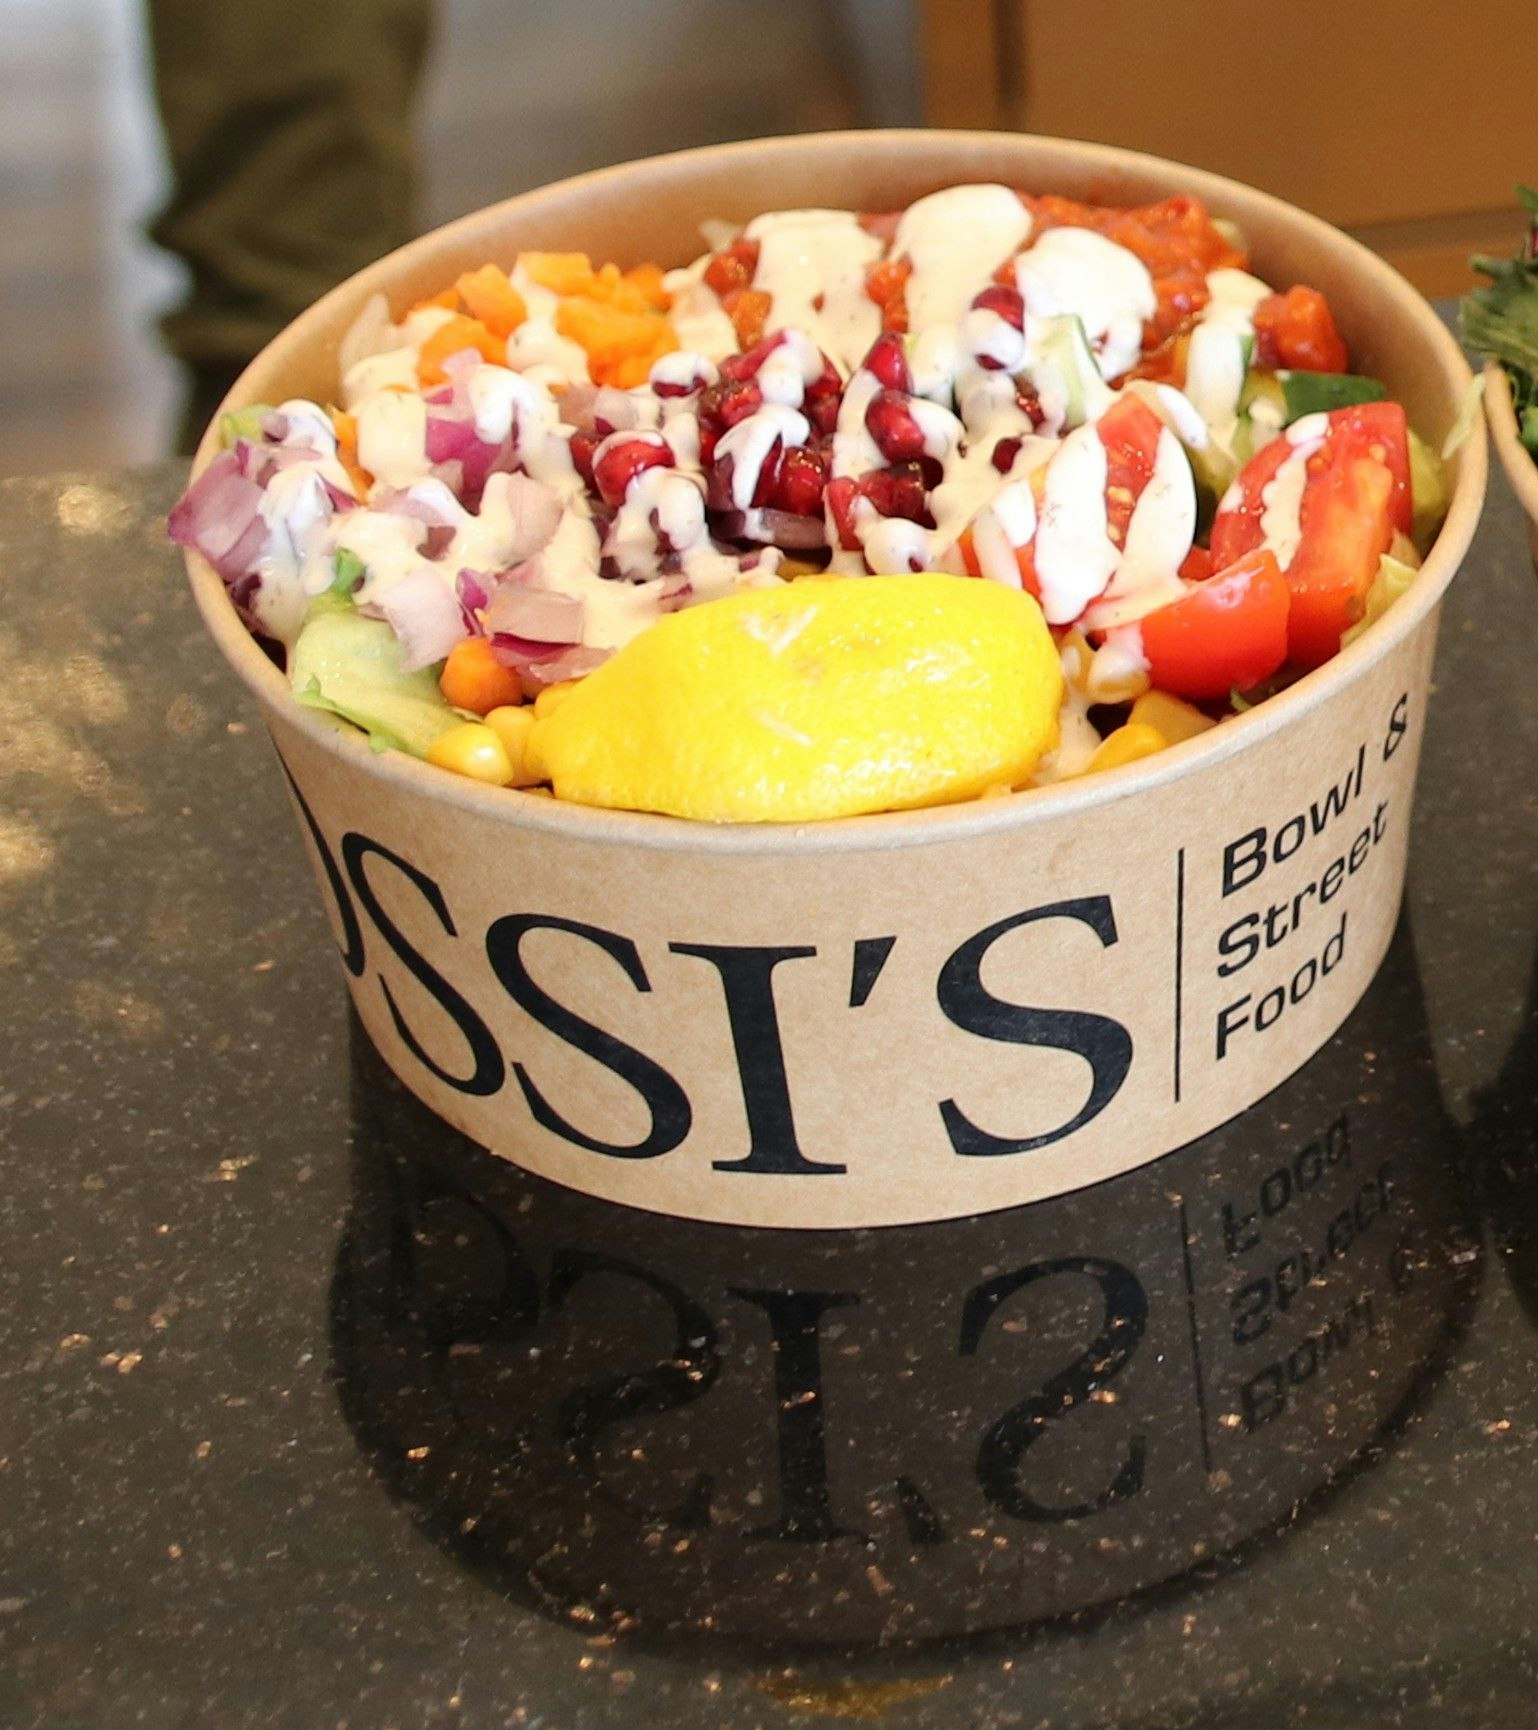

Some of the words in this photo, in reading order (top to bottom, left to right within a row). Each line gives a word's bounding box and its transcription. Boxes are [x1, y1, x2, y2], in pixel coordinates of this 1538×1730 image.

[1221, 743, 1365, 898] Bowl
[1382, 691, 1408, 763] &
[1217, 800, 1389, 979] Street
[1216, 912, 1348, 1060] Food
